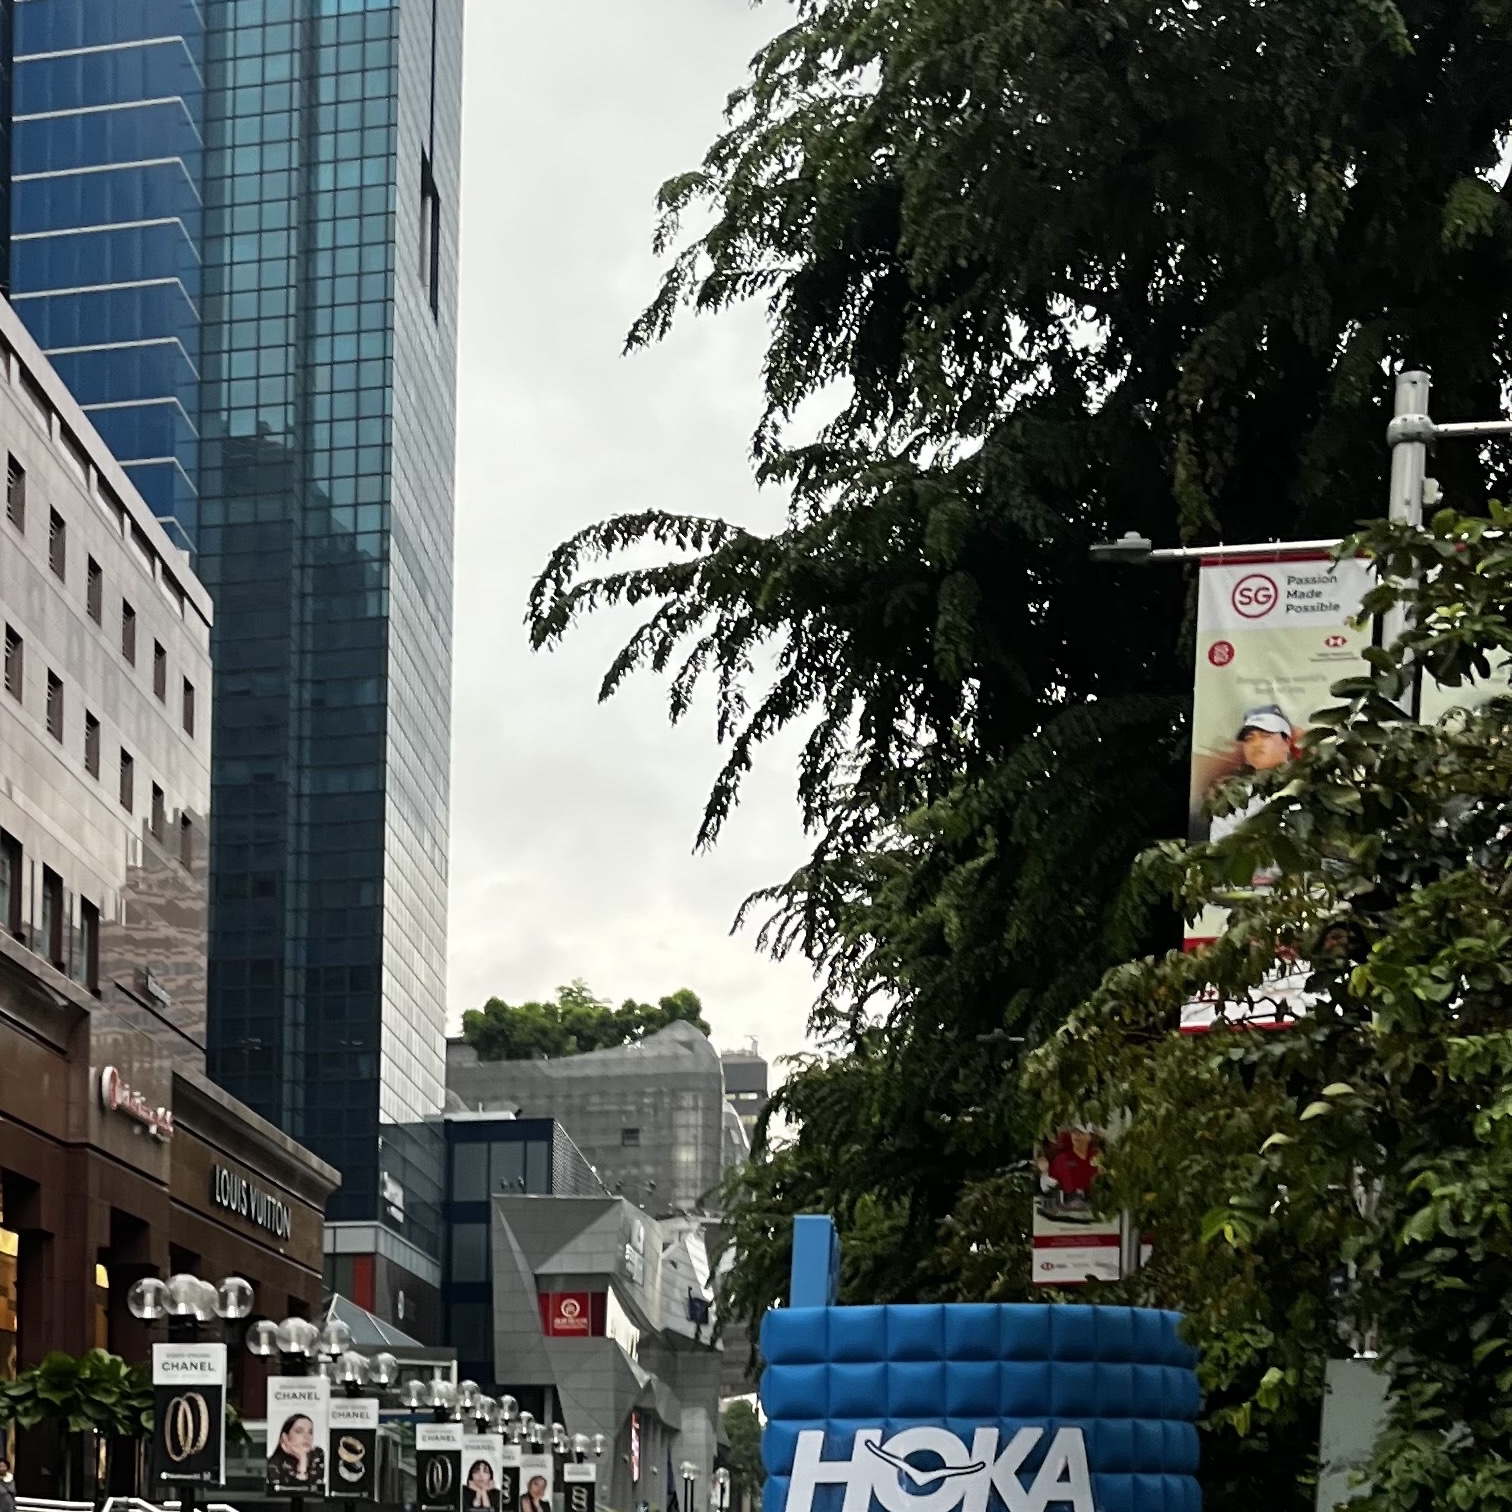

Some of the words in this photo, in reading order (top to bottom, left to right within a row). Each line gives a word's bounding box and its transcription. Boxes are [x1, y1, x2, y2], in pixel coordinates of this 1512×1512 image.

[1286, 575, 1337, 585] Passion
[1286, 589, 1322, 599] Made
[1286, 602, 1340, 613] Possible
[214, 1164, 247, 1216] LOUIS
[249, 1182, 292, 1241] VUITTON
[161, 1361, 216, 1371] CHANEL
[274, 1391, 320, 1400] CHANEL
[331, 1411, 370, 1419] CHANEL
